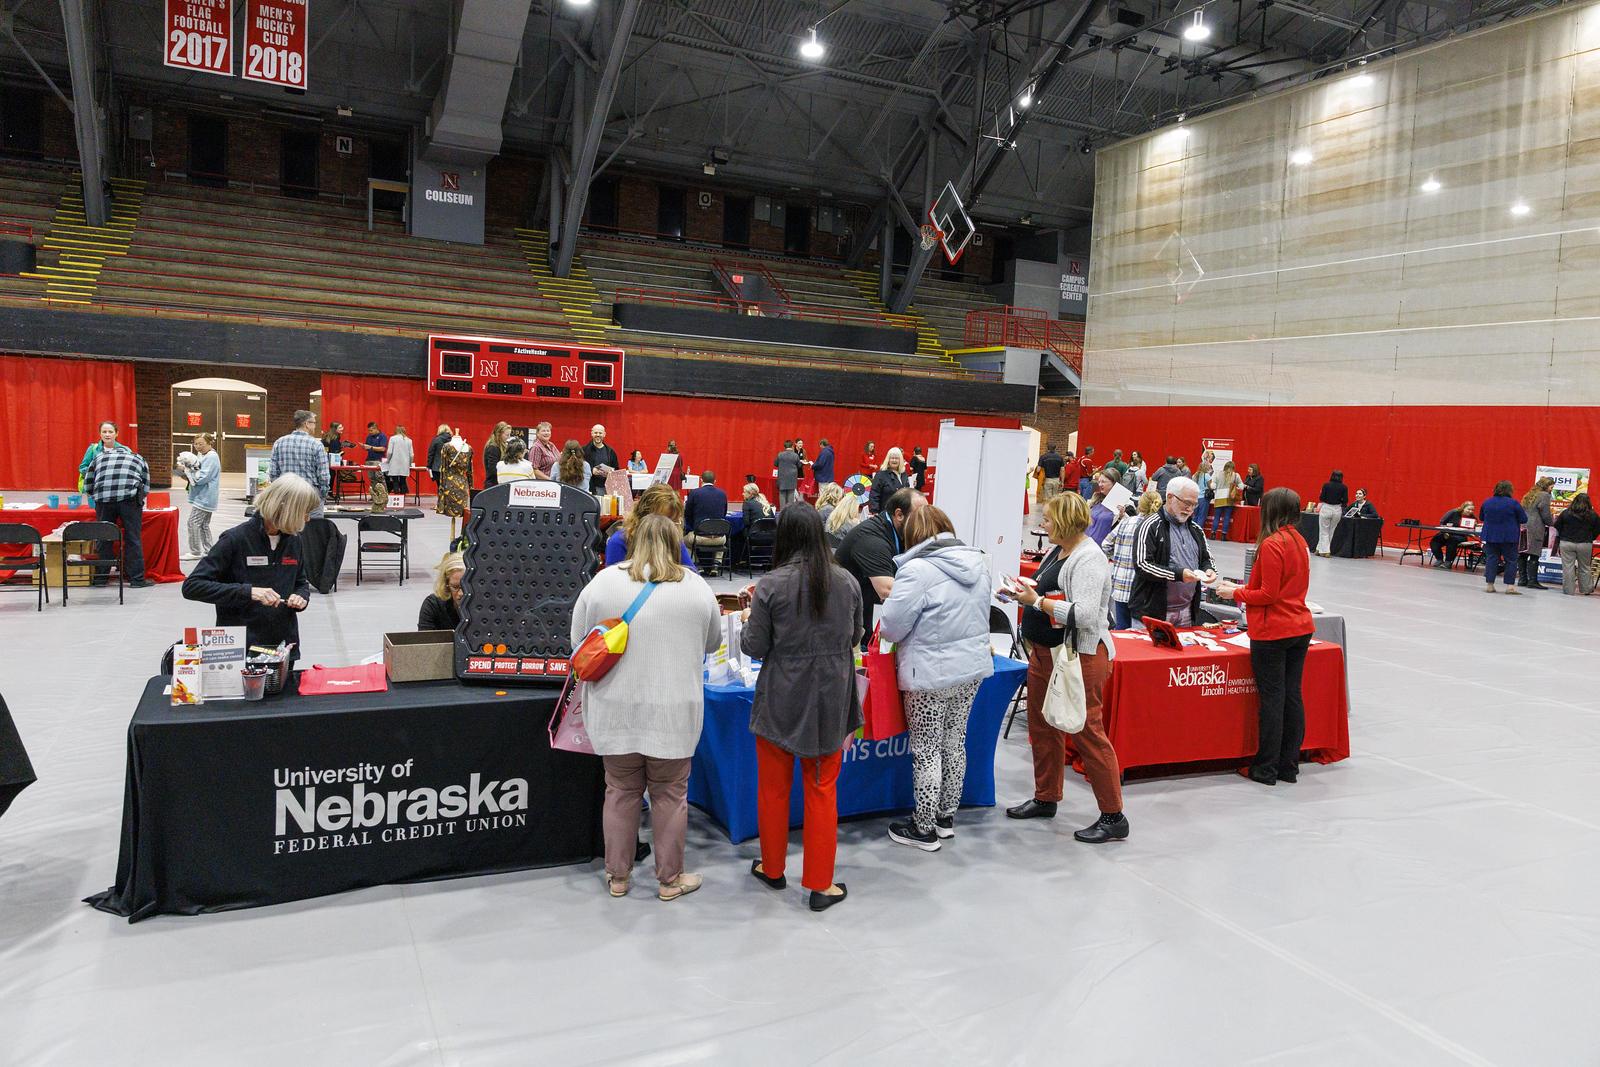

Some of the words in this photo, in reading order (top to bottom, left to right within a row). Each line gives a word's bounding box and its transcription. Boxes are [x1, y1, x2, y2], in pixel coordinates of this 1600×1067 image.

[187, 4, 212, 20] FLAG
[259, 4, 293, 22] MEN'S
[174, 14, 224, 35] FOOTBALL
[256, 16, 296, 36] HOCKEY
[263, 31, 288, 47] CLUB
[170, 29, 228, 69] 2017
[248, 43, 303, 84] 2018
[340, 140, 350, 151] N
[425, 189, 473, 206] COLISEUM
[1061, 274, 1086, 285] CAMPUS
[1062, 291, 1083, 301] CENTER
[513, 347, 548, 356] #ActiveHusker
[480, 359, 499, 378] N
[560, 365, 578, 383] N
[513, 487, 557, 498] Nebraska
[202, 633, 235, 647] Cents
[469, 661, 492, 670] SPEND
[494, 661, 518, 670] PROTECT
[521, 661, 545, 670] BORROW
[549, 662, 567, 672] SAVE
[1167, 663, 1226, 688] Nebraska
[1201, 685, 1224, 697] Lincoln
[1227, 686, 1245, 695] HEALTH
[273, 762, 385, 788] University
[391, 758, 414, 778] of
[275, 772, 529, 836] Nebraska
[273, 831, 373, 855] FEDERAL
[381, 821, 457, 844] CREDIT
[466, 813, 527, 833] UNION
